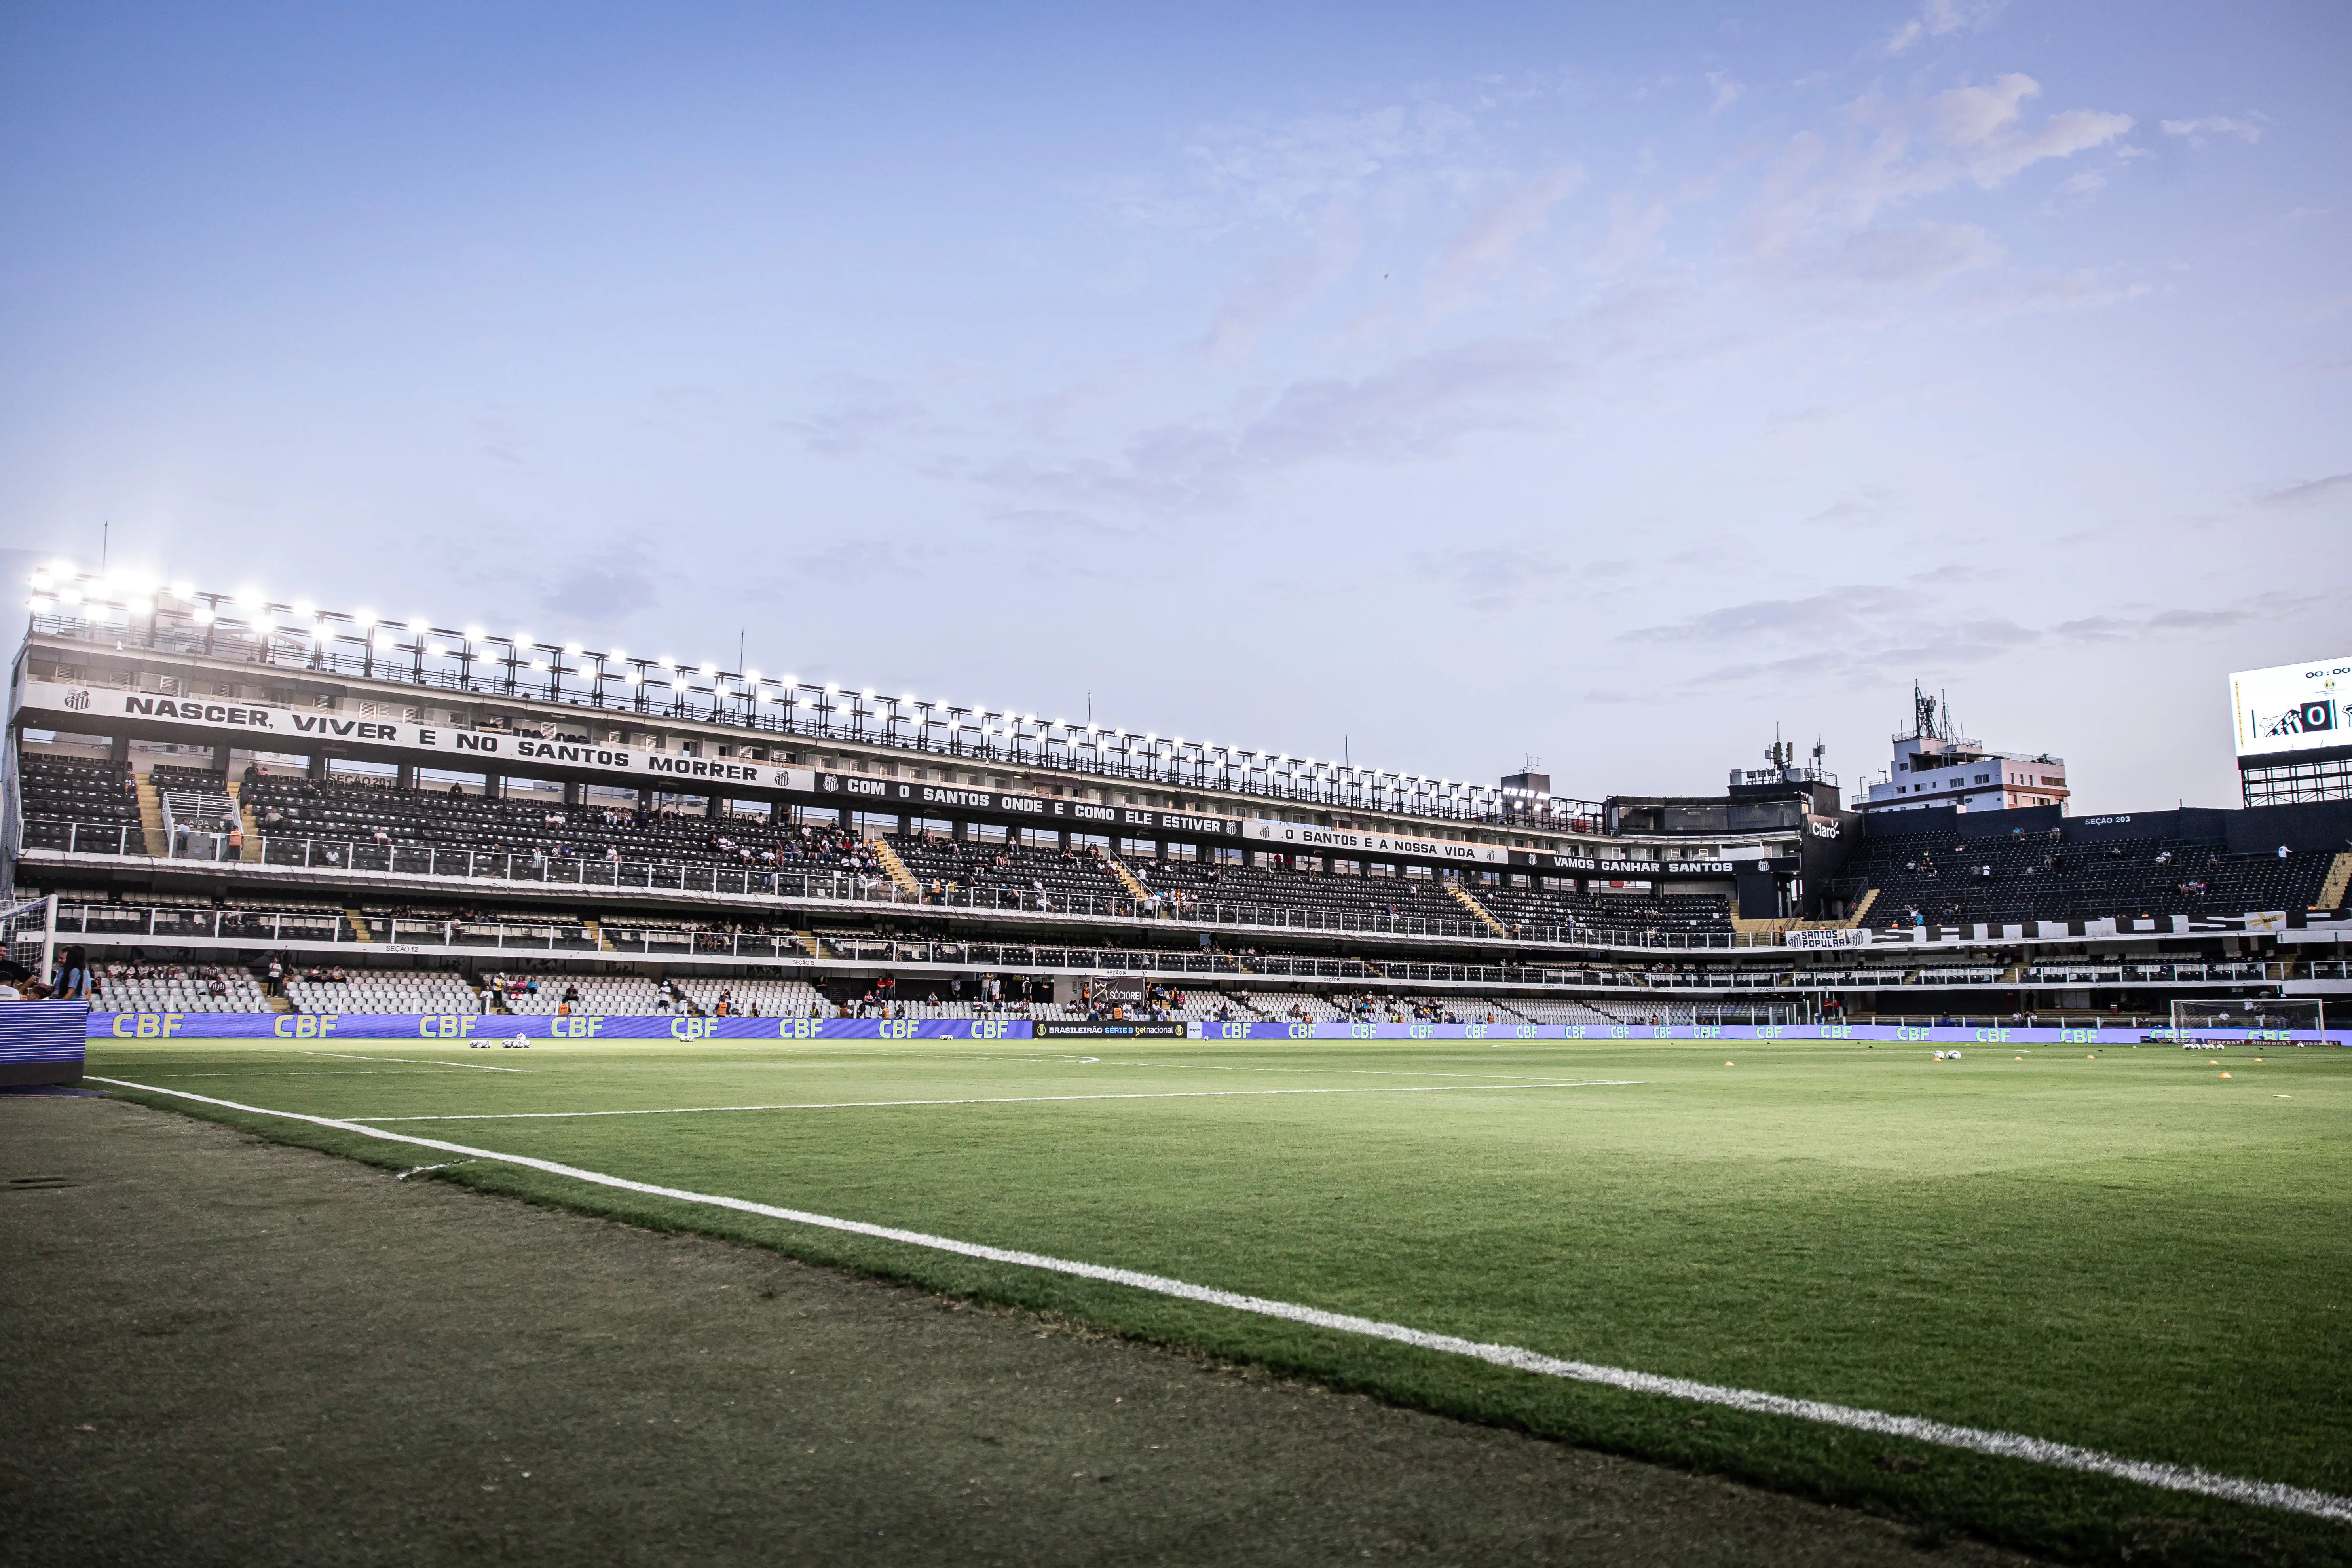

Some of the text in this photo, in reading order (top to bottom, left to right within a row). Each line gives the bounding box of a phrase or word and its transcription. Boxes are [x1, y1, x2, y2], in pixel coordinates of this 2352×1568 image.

[2307, 706, 2325, 725] 0
[125, 697, 757, 781] NASCER, VIVER E NO SANTOS MORRER
[848, 779, 885, 795] COM
[899, 785, 909, 798] O
[923, 788, 989, 806] SANTOS
[1002, 797, 1043, 812] ONDE
[1055, 803, 1063, 814] E
[1075, 805, 1114, 820] COMO
[1126, 811, 1152, 825] ELE
[1163, 815, 1220, 832] ESTIVER
[2085, 816, 2113, 826] SEÇÃO
[1813, 820, 1837, 839] Claro
[1285, 830, 1293, 839] O
[1303, 831, 1357, 846] SANTOS
[1365, 836, 1372, 848] É
[1379, 840, 1388, 849] A
[1395, 841, 1437, 854] NOSSA
[1444, 846, 1475, 858] VIDA
[1554, 856, 1733, 872] VAMOS GANHAR SANTOS
[1801, 930, 1838, 939] SANTOS
[1803, 939, 1846, 948] POPULAR
[1109, 989, 1141, 1000] SÓCIOREI
[112, 1014, 184, 1038] CBF
[274, 1014, 339, 1037] CBF
[420, 1016, 478, 1037] CBF
[551, 1016, 604, 1037] CBF
[671, 1017, 719, 1037] CBF
[780, 1019, 823, 1038] CBF
[879, 1019, 919, 1038] CBF
[971, 1021, 1008, 1038] CBF
[1135, 1025, 1173, 1035] betnacional
[1222, 1023, 1251, 1038] CBF
[1289, 1023, 1316, 1038] CBF
[1351, 1024, 1377, 1038] CBF
[1410, 1024, 1434, 1038] CBF
[1465, 1025, 1488, 1038] CBF
[1517, 1025, 1538, 1038] CBF
[1565, 1026, 1585, 1039] CBF
[1611, 1026, 1630, 1039] CBF
[1653, 1026, 1671, 1039] CBF
[1693, 1026, 1721, 1038] CBF
[1756, 1026, 1783, 1038] CBF
[1820, 1025, 1853, 1038] CBF
[1897, 1027, 1930, 1040] CBF
[1976, 1029, 2010, 1042] CBF
[2060, 1029, 2098, 1043] CBF
